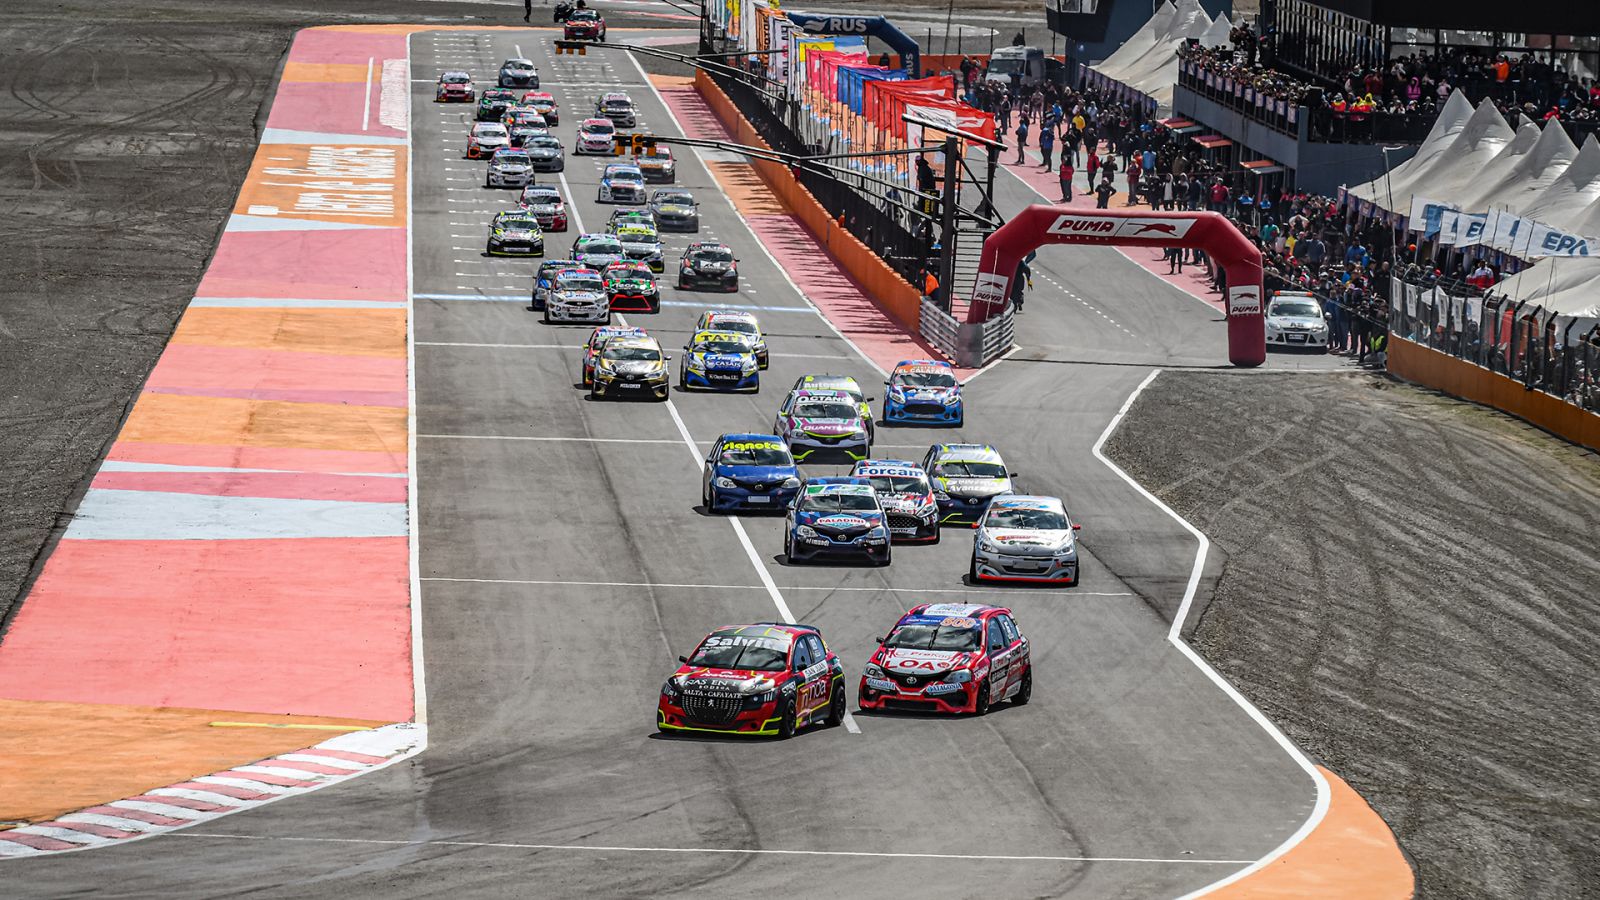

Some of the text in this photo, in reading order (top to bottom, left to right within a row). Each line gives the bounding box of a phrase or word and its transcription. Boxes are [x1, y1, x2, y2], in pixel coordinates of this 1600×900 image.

[830, 18, 867, 33] RUS
[1057, 219, 1115, 232] PUMA
[975, 292, 1002, 302] PUMA
[1232, 305, 1259, 314] PUMA
[858, 467, 923, 478] Forcam
[708, 691, 743, 699] CAFAYATE
